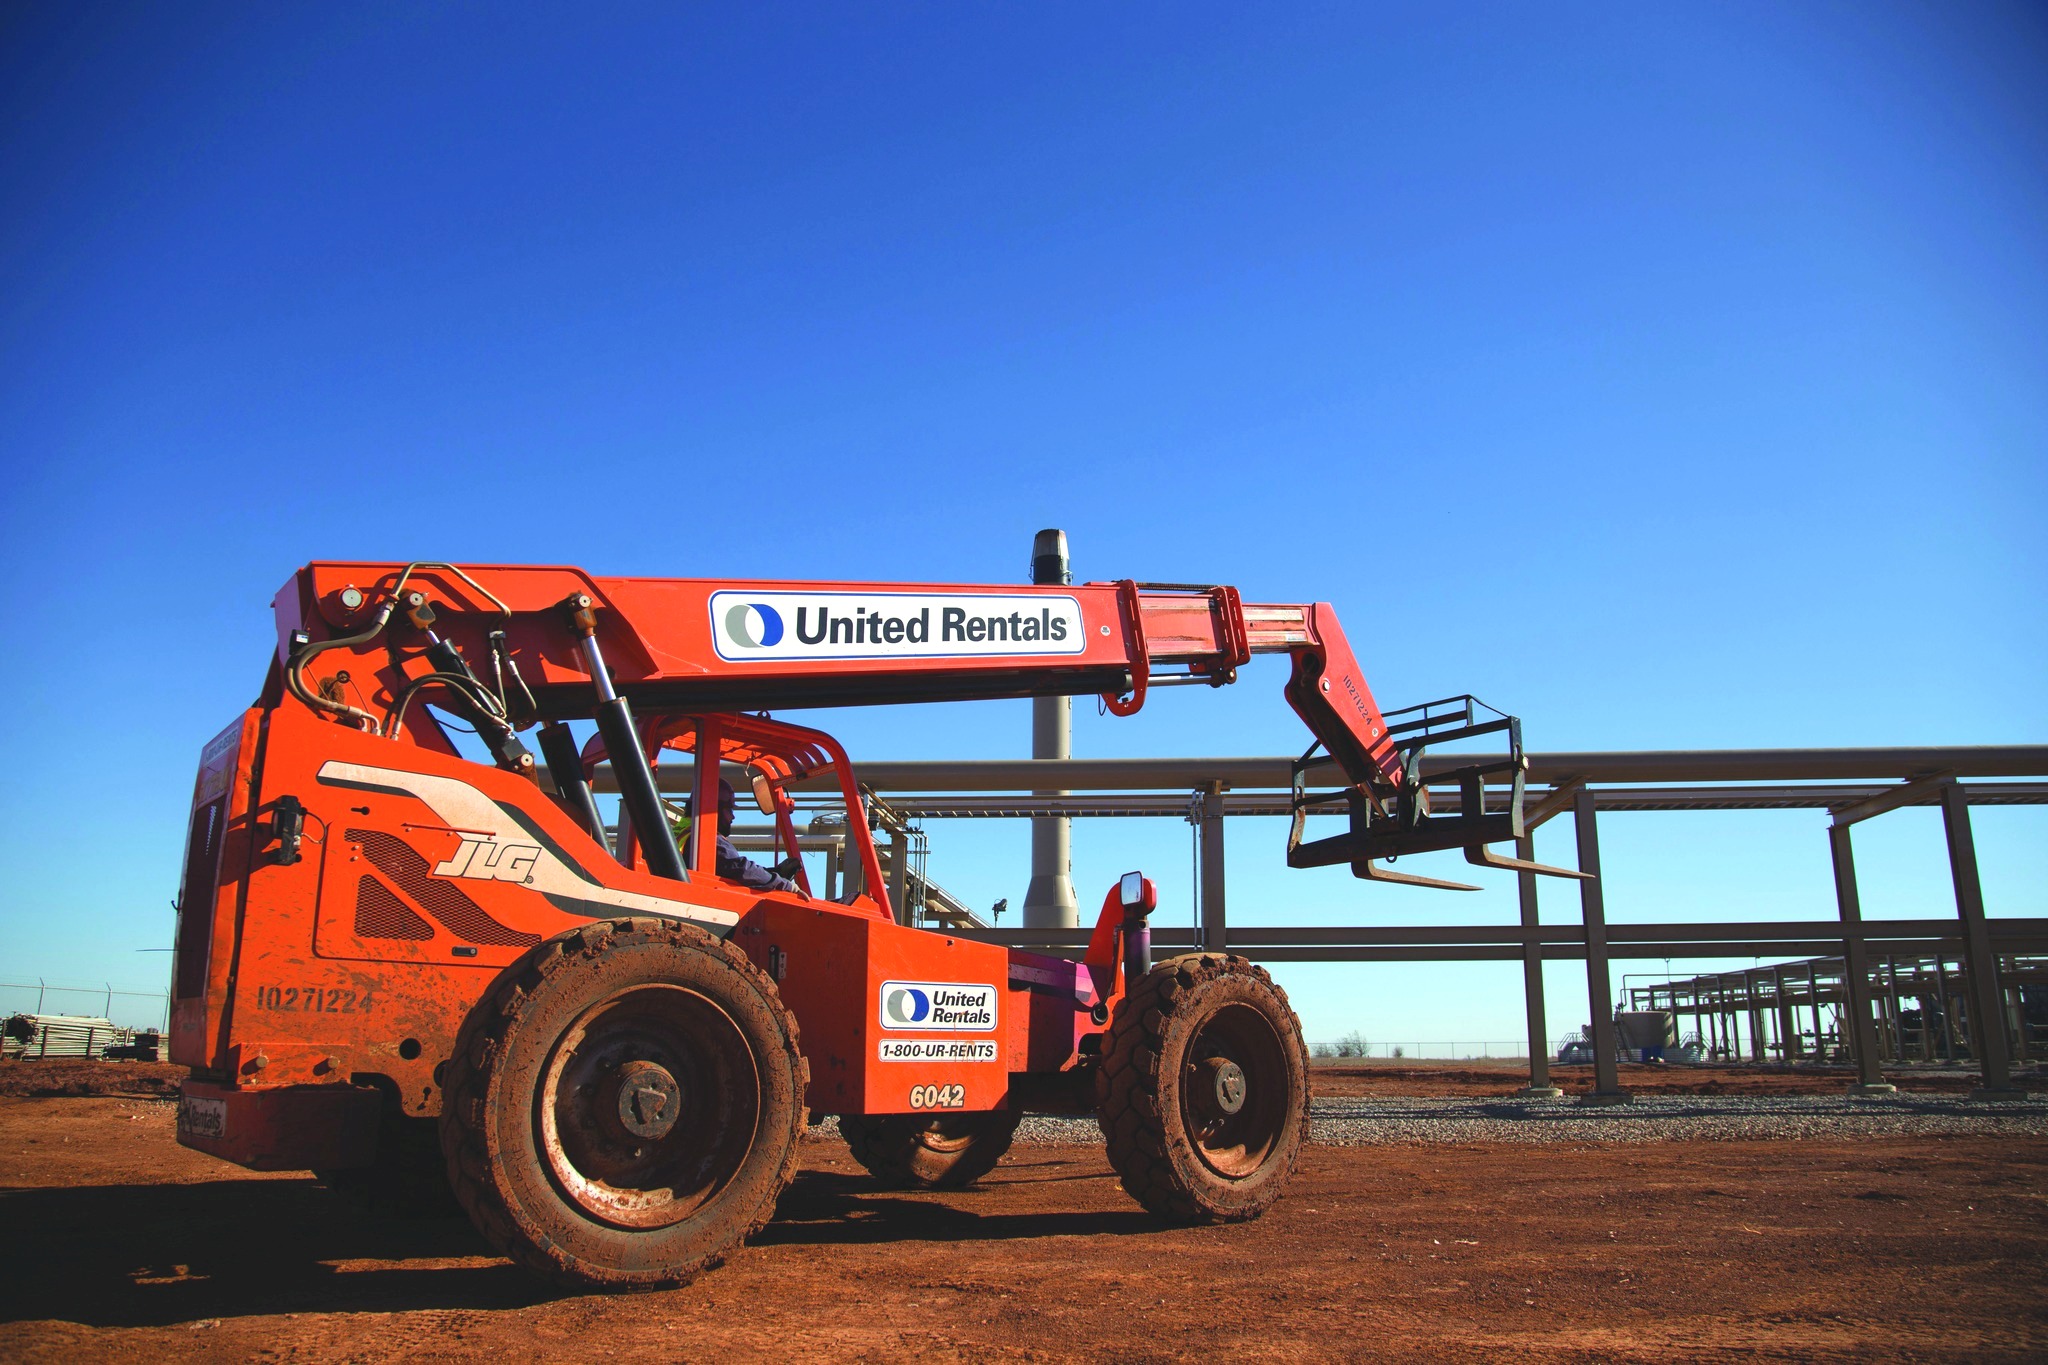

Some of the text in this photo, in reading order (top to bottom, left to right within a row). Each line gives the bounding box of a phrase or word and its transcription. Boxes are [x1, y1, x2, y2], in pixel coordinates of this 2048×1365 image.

[796, 607, 1067, 645] United Rentals
[1343, 675, 1372, 725] 10271224
[432, 839, 542, 883] JLG
[257, 986, 373, 1014] 10271224
[933, 990, 987, 1007] United
[932, 1007, 991, 1024] Rentals
[883, 1044, 994, 1058] 1-800-UR-RENTS
[909, 1083, 965, 1110] 6042
